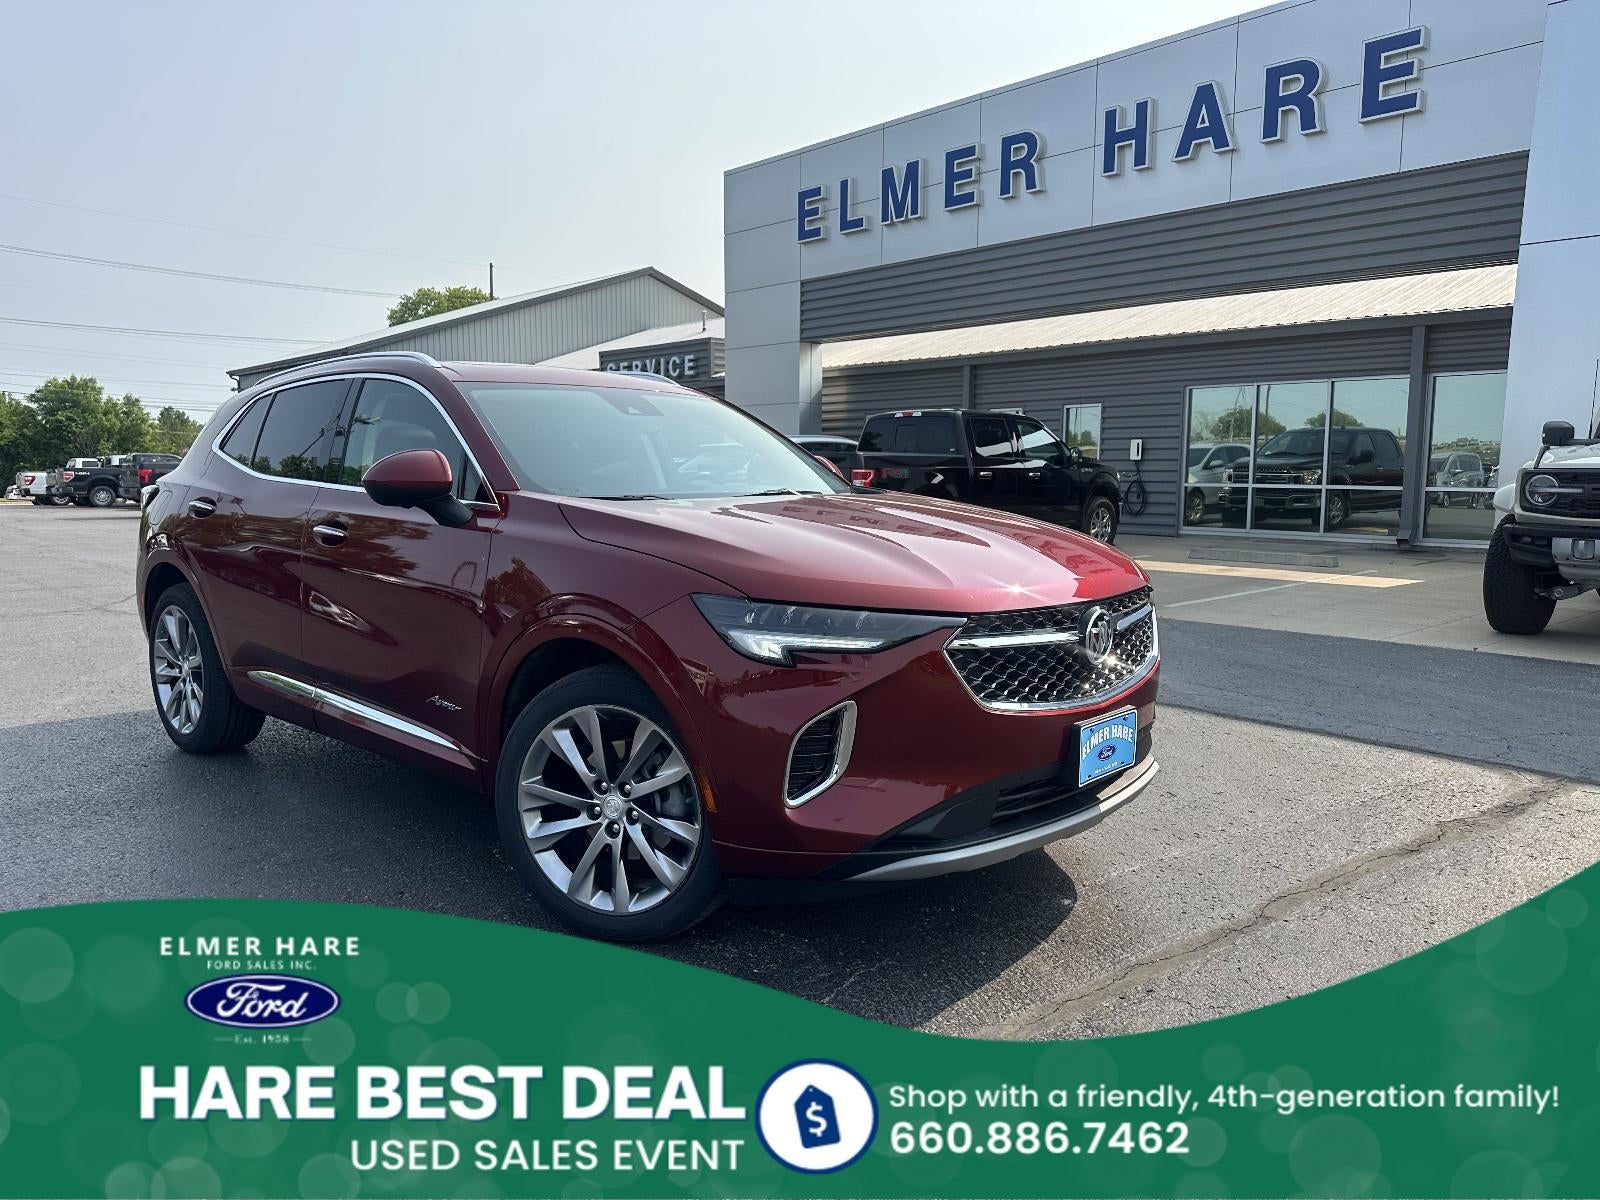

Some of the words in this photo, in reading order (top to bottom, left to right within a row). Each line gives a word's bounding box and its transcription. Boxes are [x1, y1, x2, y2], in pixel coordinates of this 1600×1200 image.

[797, 129, 1046, 243] ELMER
[1102, 25, 1428, 178] HARE
[1082, 726, 1110, 759] ELMER
[1111, 724, 1134, 742] HARE
